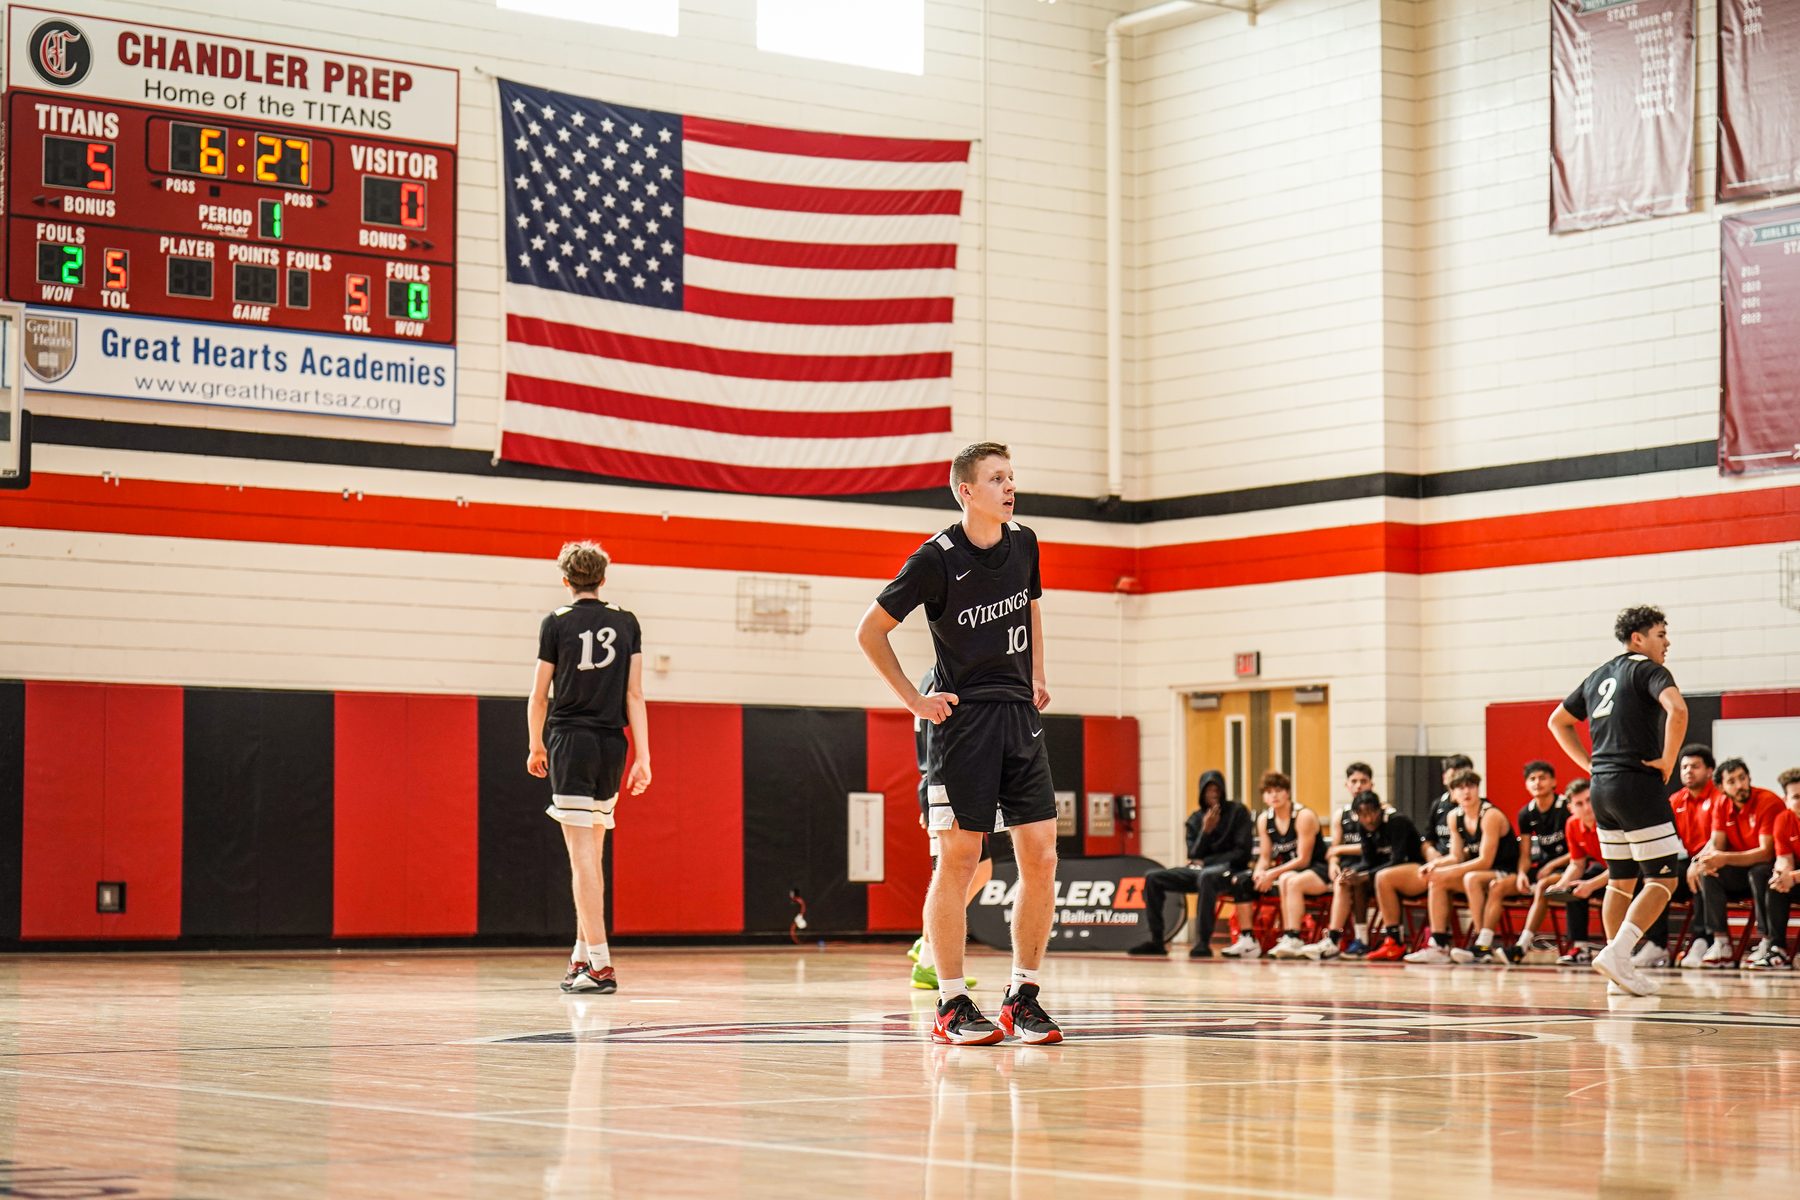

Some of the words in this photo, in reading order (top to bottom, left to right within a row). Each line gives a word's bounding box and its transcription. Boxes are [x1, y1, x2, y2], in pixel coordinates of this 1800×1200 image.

[117, 31, 309, 90] CHANDLER
[323, 60, 413, 102] PREP
[35, 103, 119, 139] TITANS
[144, 79, 215, 106] Home
[223, 92, 247, 111] of
[259, 96, 295, 118] the
[303, 100, 392, 130] TITANS
[87, 143, 112, 190] 5
[200, 127, 309, 186] 6:27
[350, 144, 438, 180] VISITOR
[166, 178, 196, 194] POSS
[284, 192, 313, 208] POSS
[64, 195, 116, 217] BONUS
[199, 204, 253, 226] PERIOD
[273, 202, 281, 239] 1
[401, 182, 424, 227] 0
[36, 223, 85, 244] FOULS
[159, 236, 215, 258] PLAYER
[359, 229, 407, 251] BONUS
[62, 245, 83, 285] 2
[106, 251, 127, 289] 5
[228, 244, 280, 266] POINTS
[286, 250, 332, 272] FOULS
[386, 261, 431, 282] FOULS
[42, 284, 74, 303] WON
[100, 290, 130, 309] TOL
[348, 276, 368, 314] 5
[408, 281, 429, 320] 0
[232, 304, 271, 322] GAME
[343, 314, 371, 334] TOL
[395, 320, 424, 337] WON
[101, 327, 181, 363] Great
[193, 336, 287, 373] Hearts
[300, 347, 445, 387] Academies
[135, 376, 401, 415] www.greatheartsaz.org
[577, 626, 617, 671] 13
[1006, 625, 1029, 655] 10
[1591, 677, 1617, 719] 2
